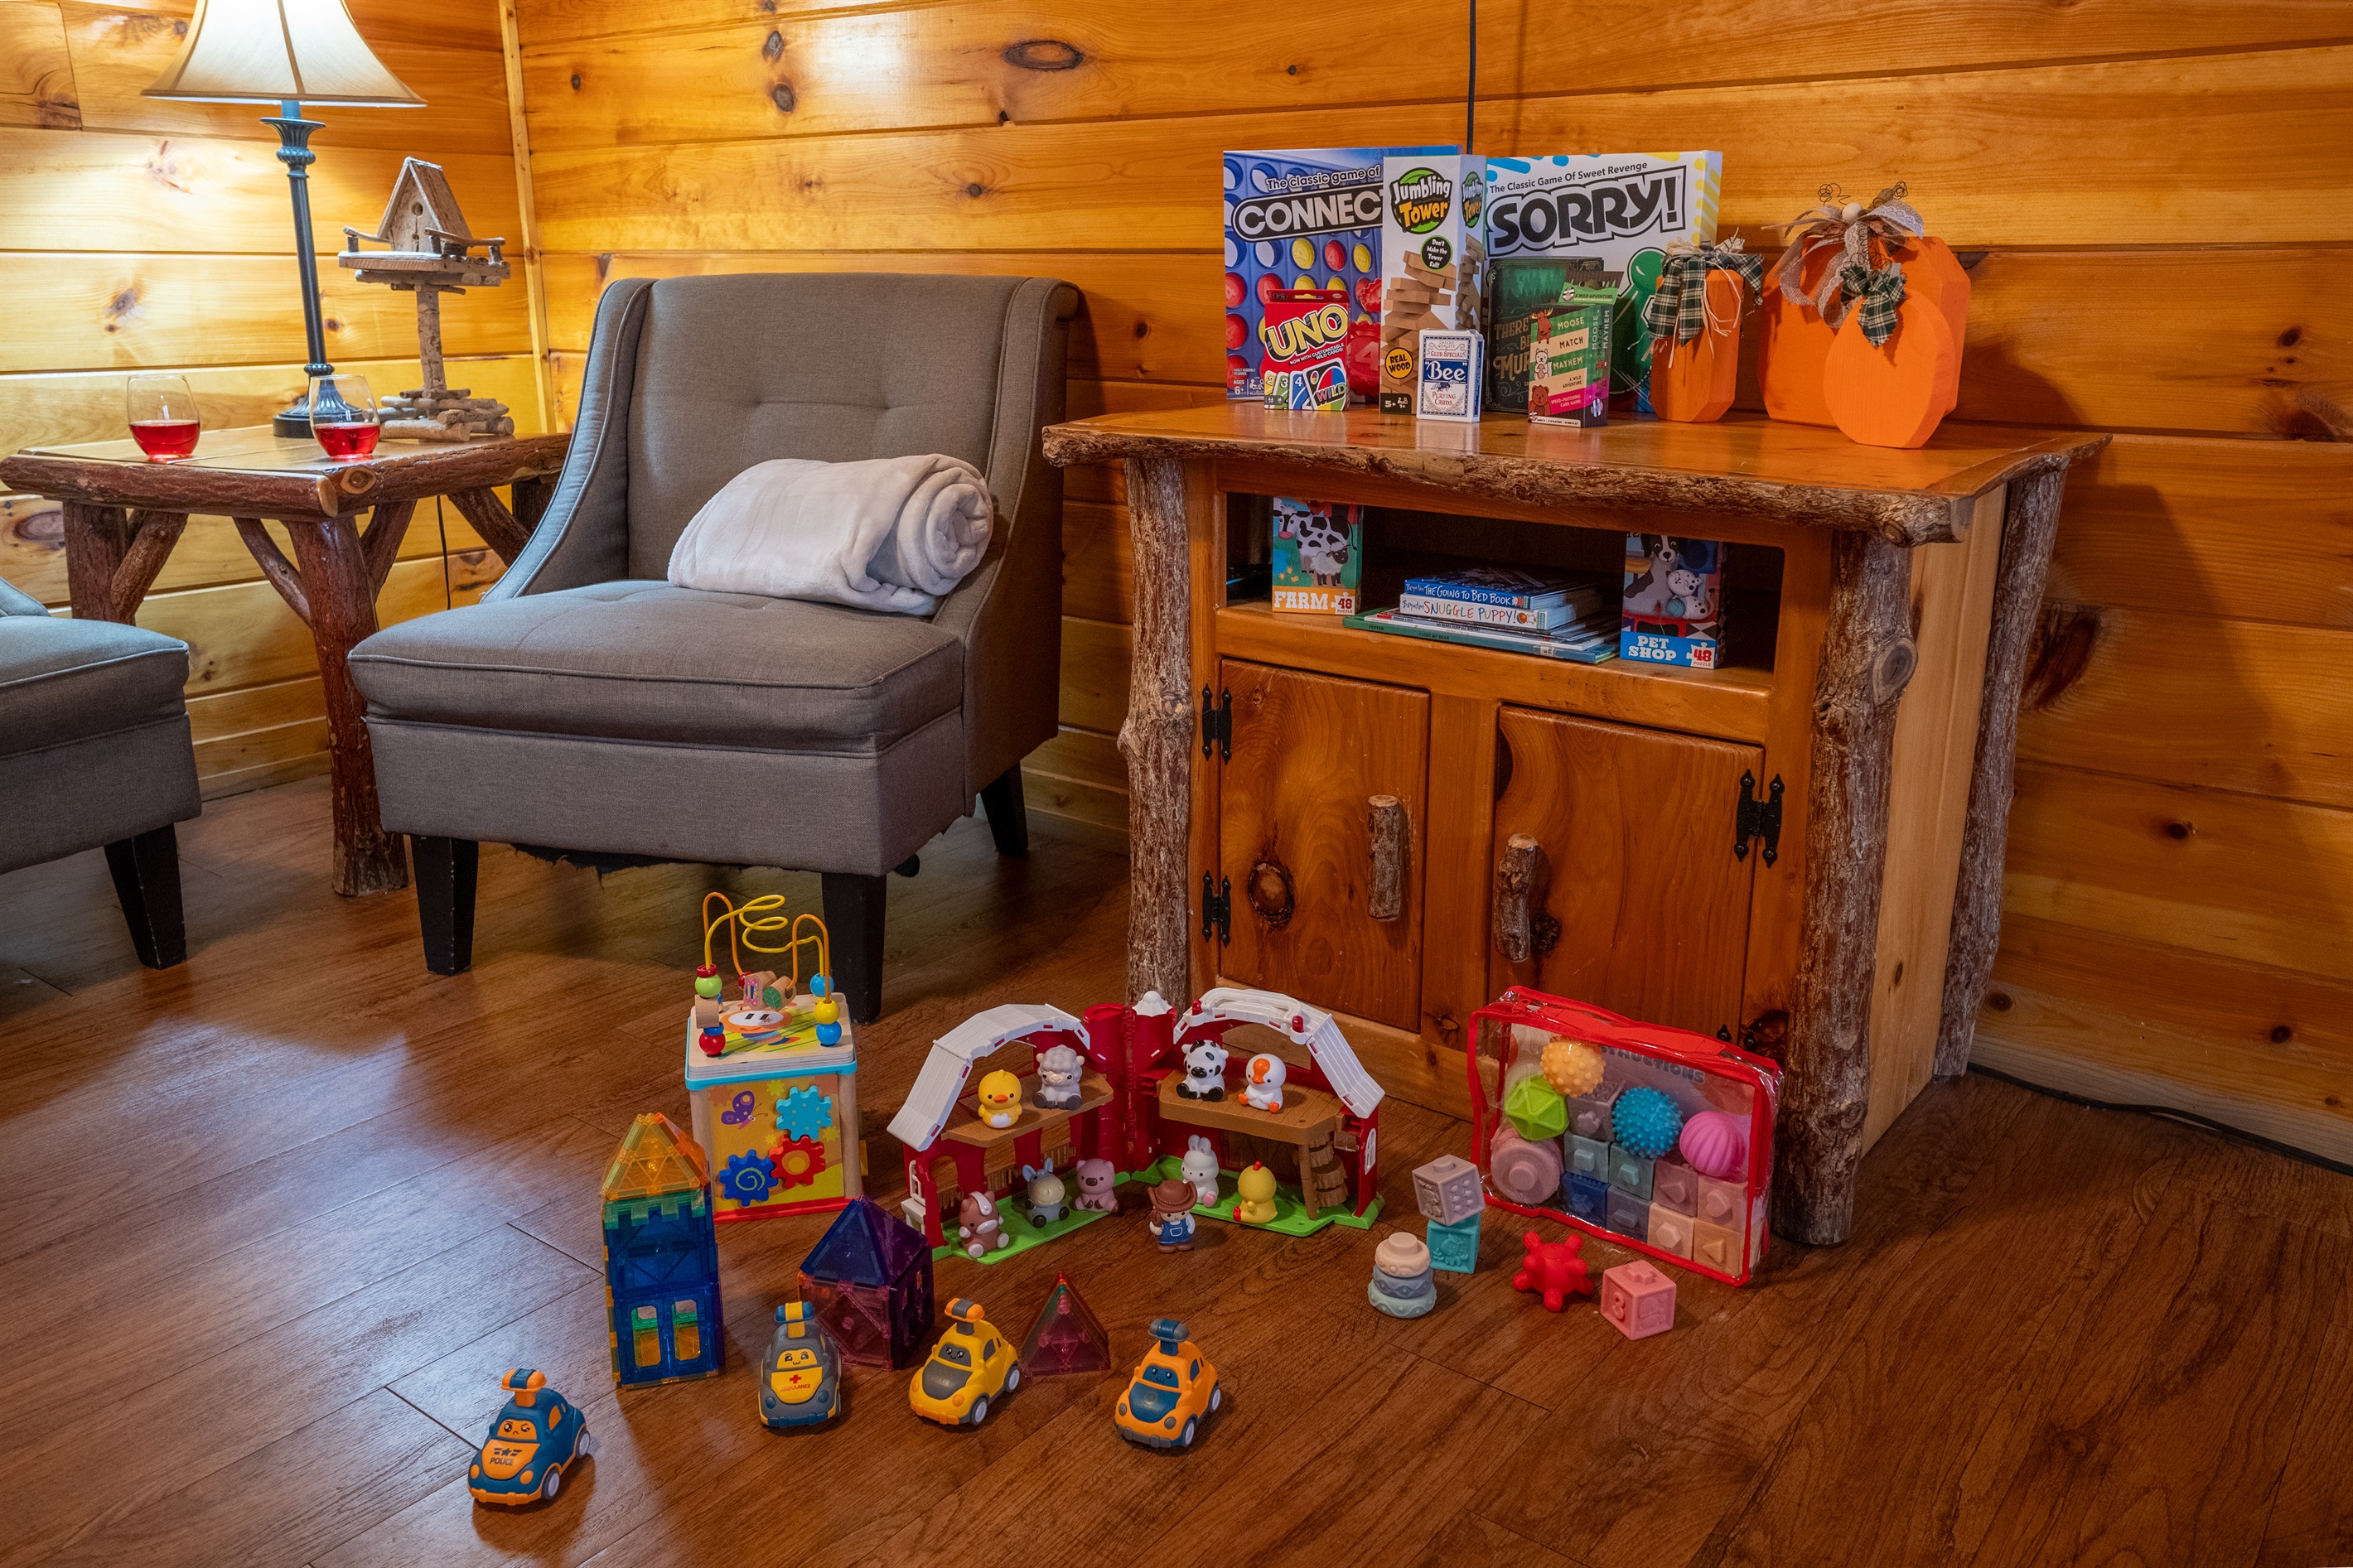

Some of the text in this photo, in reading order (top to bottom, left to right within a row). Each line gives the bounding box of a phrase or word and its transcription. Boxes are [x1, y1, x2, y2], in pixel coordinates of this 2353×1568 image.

[1266, 165, 1380, 191] The classic game of
[1489, 162, 1648, 194] The Classic Game Of Sweet Revenge
[1392, 174, 1452, 205] Jumbling
[1239, 191, 1383, 235] CONNEC
[1399, 200, 1448, 228] Tower
[1492, 176, 1679, 249] SORRY!
[1426, 245, 1439, 253] Make
[1428, 253, 1443, 262] Tower
[1495, 315, 1531, 340] THERE'
[1558, 316, 1585, 330] MOOSE
[1266, 304, 1348, 359] UNO
[1559, 336, 1584, 349] MATCH
[1312, 343, 1344, 357] CUSTOMIZABLE
[1355, 341, 1379, 372] 4
[1389, 354, 1407, 364] REAL
[1553, 357, 1583, 370] MAYHEM
[1389, 362, 1411, 373] WOOD
[1266, 376, 1274, 386] 2
[1280, 378, 1288, 388] 3
[1295, 376, 1302, 387] 4
[1563, 380, 1582, 388] ADVENTURE
[1234, 386, 1244, 395] 6+
[1316, 383, 1347, 403] WILD
[1432, 391, 1457, 399] PLAYING
[1274, 591, 1329, 610] FARM
[1406, 583, 1424, 593] Boynton
[1424, 584, 1437, 596] THE
[1437, 586, 1460, 598] GOING
[1461, 591, 1470, 600] TO
[1471, 590, 1488, 602] BED
[1489, 593, 1511, 605] BOOK
[1338, 598, 1353, 609] 48
[1403, 600, 1516, 624] Boynton SNUGGLE PUPPY!
[1637, 635, 1669, 649] PET
[1628, 645, 1676, 661] SHOP
[1693, 649, 1712, 662] 48
[780, 1384, 811, 1392] AMBULANCE
[490, 1457, 515, 1466] POLICE
